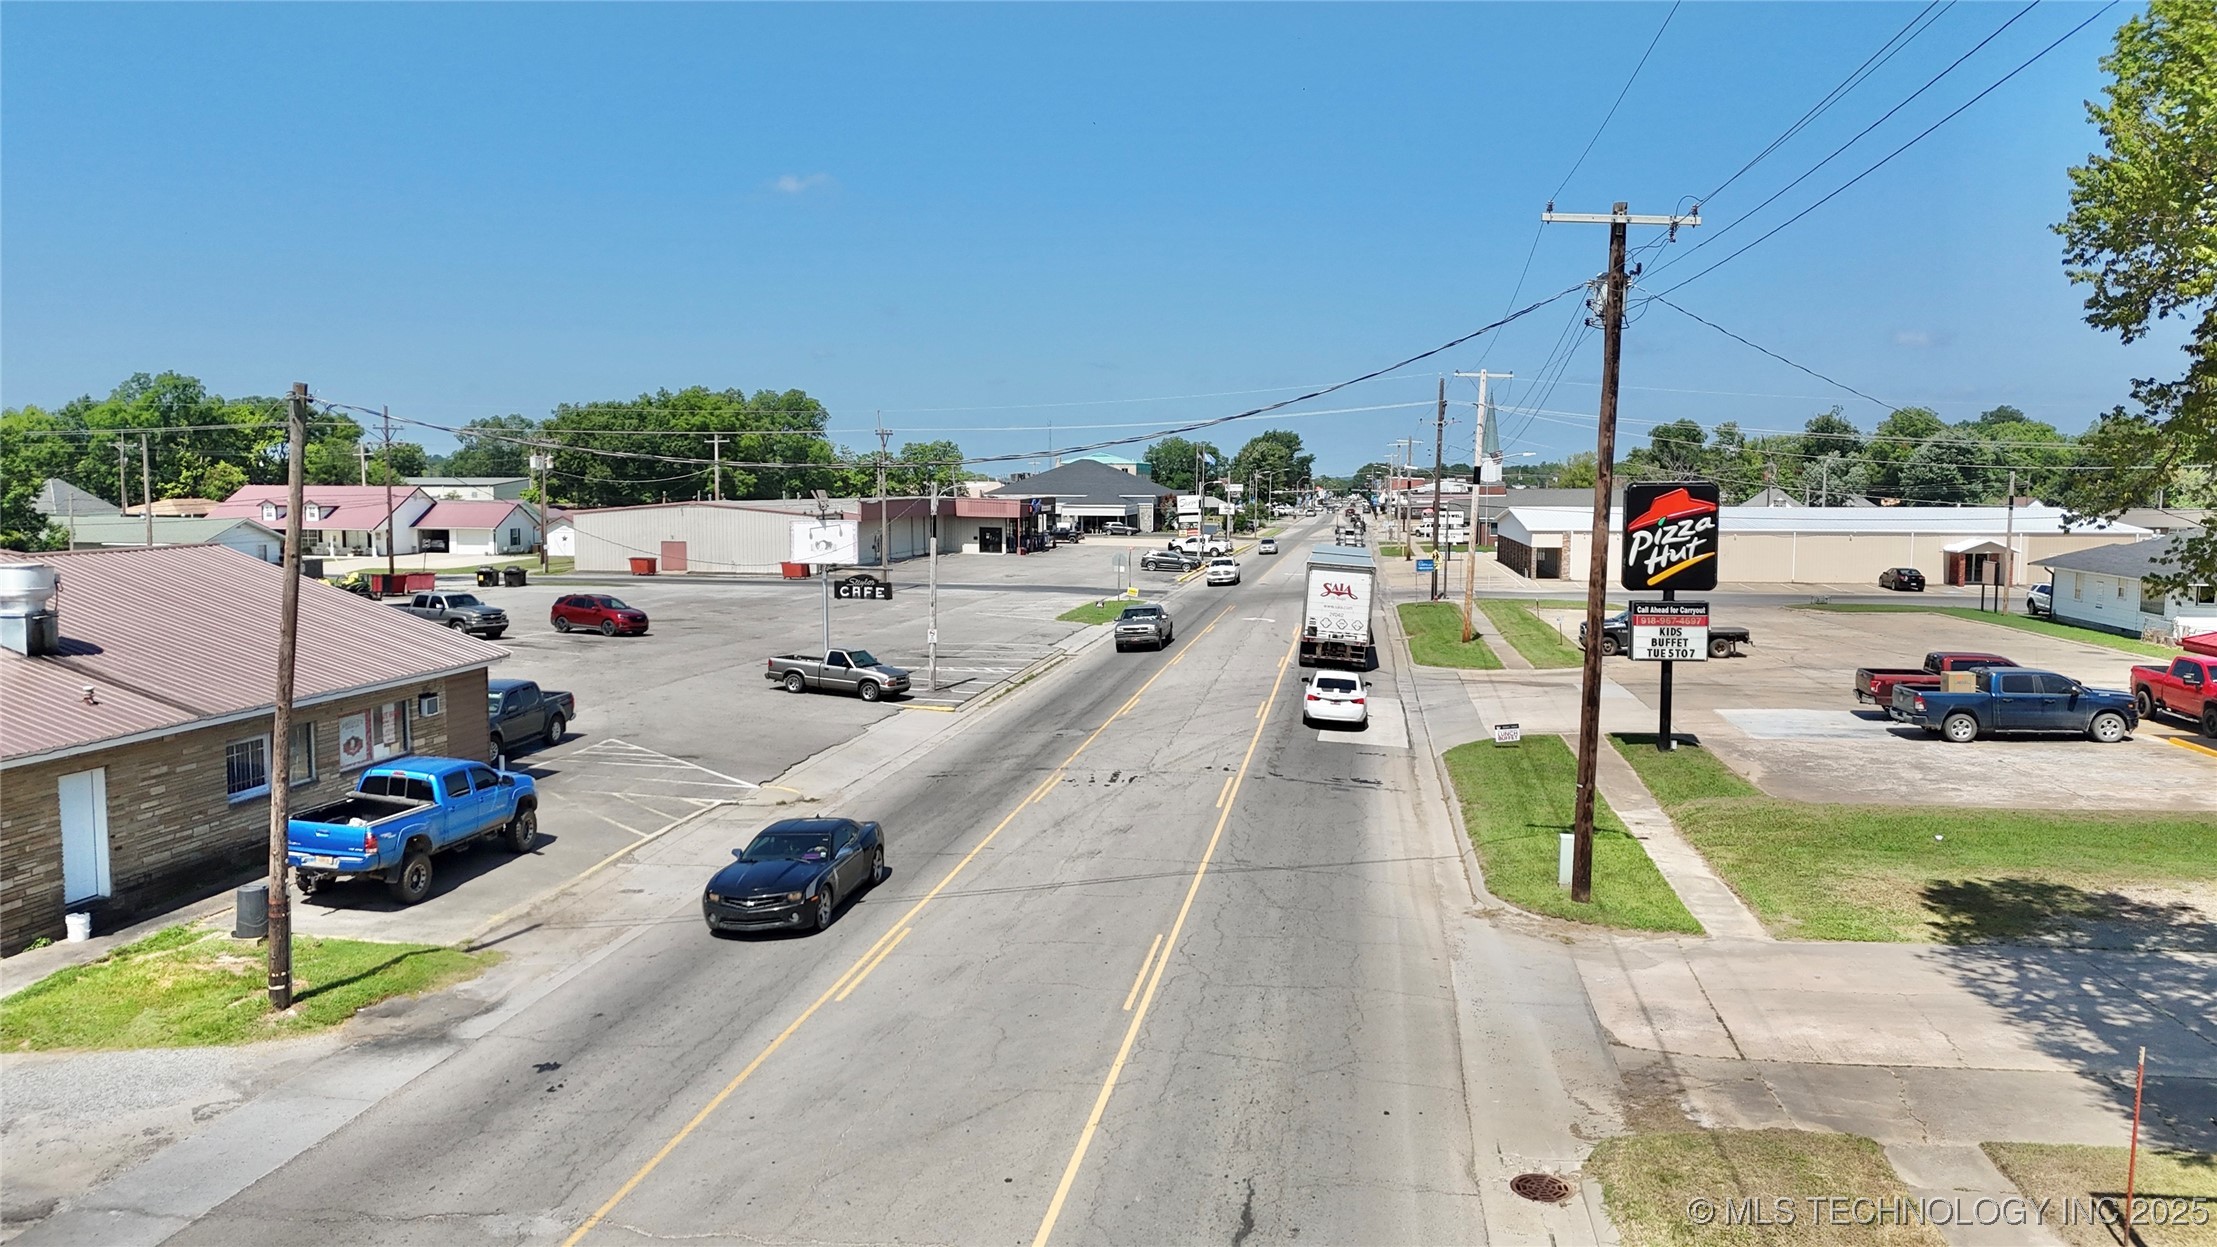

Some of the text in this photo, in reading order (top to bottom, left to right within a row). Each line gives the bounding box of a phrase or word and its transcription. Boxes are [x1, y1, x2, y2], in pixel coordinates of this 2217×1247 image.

[1628, 516, 1716, 567] Pizza
[1643, 536, 1708, 575] Hut
[840, 586, 885, 598] CAFE
[1637, 606, 1706, 616] Call Ahead for Carryout
[1659, 627, 1683, 637] KIDS
[1651, 638, 1689, 647] BUFFET
[1647, 648, 1666, 658] TUE
[1689, 648, 1696, 658] 7
